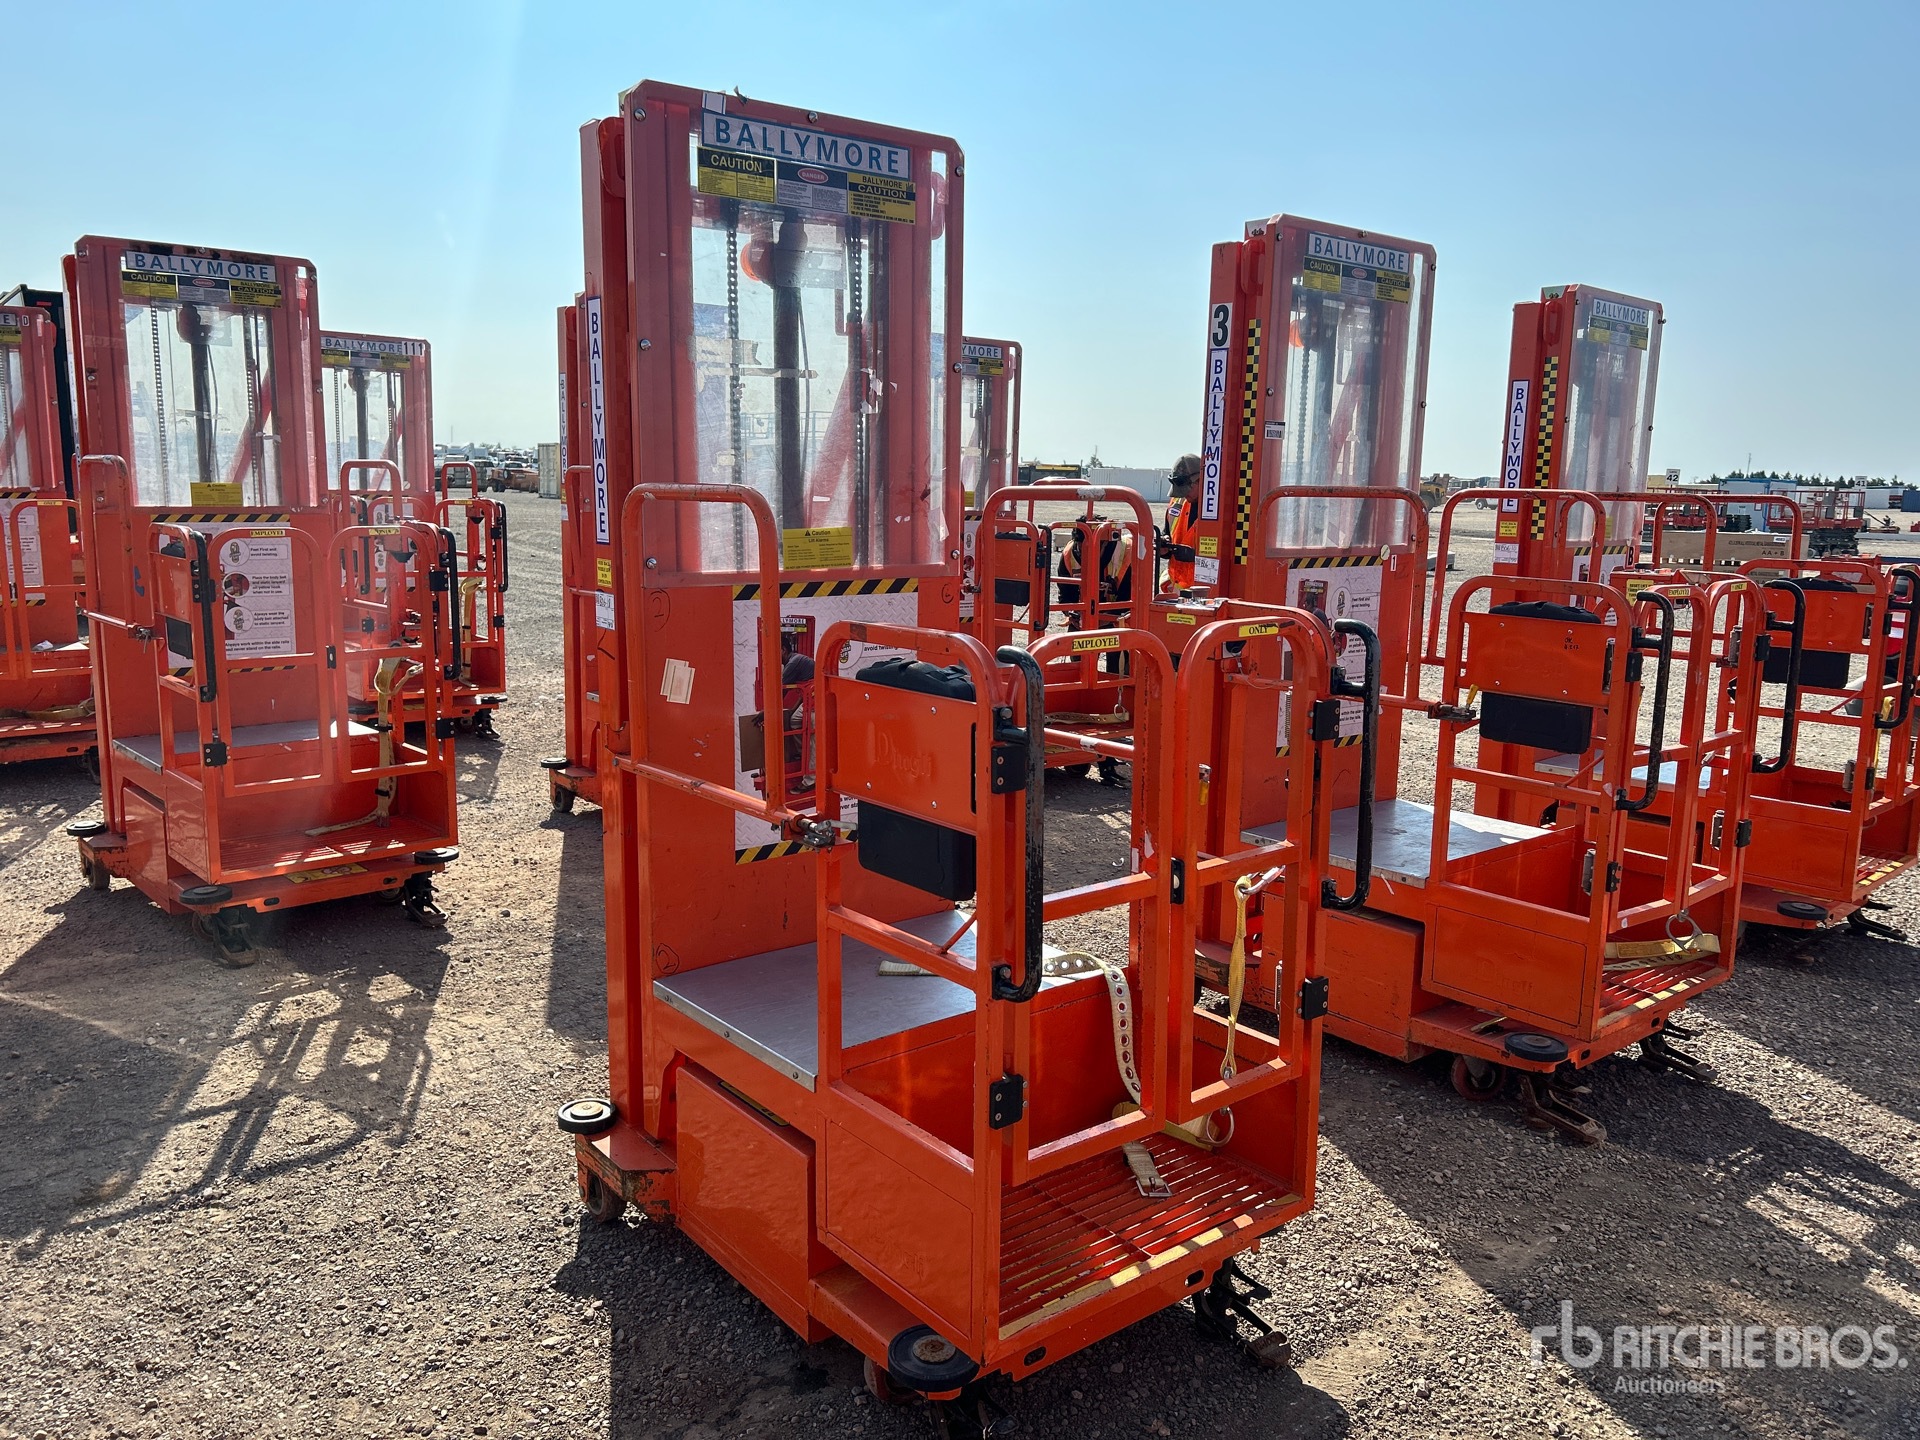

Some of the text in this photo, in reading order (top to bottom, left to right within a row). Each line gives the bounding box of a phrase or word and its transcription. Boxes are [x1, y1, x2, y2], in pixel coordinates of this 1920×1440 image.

[715, 117, 899, 174] BALLYMORE
[710, 153, 763, 173] CAUTION
[801, 171, 826, 181] DANGER
[862, 175, 903, 190] BALLYMORE
[857, 184, 907, 199] CAUTION
[1314, 236, 1405, 271] BALLYMORE
[134, 253, 269, 280] BALLYMORE
[1309, 260, 1336, 273] CAUTION
[131, 273, 168, 283] CAUTION
[240, 281, 271, 289] BALLYMORE
[1381, 279, 1406, 287] CAUTION
[237, 286, 275, 295] CAUTION
[1595, 301, 1646, 324] BALLYMORE
[1212, 304, 1230, 347] 3
[325, 338, 403, 353] BALLYMORE
[403, 341, 423, 356] 111
[591, 312, 606, 533] BALLYMORE
[1206, 359, 1224, 513] BALLYMORE
[1507, 388, 1525, 507] BALLYMORE
[1666, 474, 1679, 482] 42
[1392, 556, 1396, 570] 1
[1248, 625, 1269, 635] ONLY
[863, 644, 878, 652] avoid
[1071, 636, 1120, 650] EMPLOYEE
